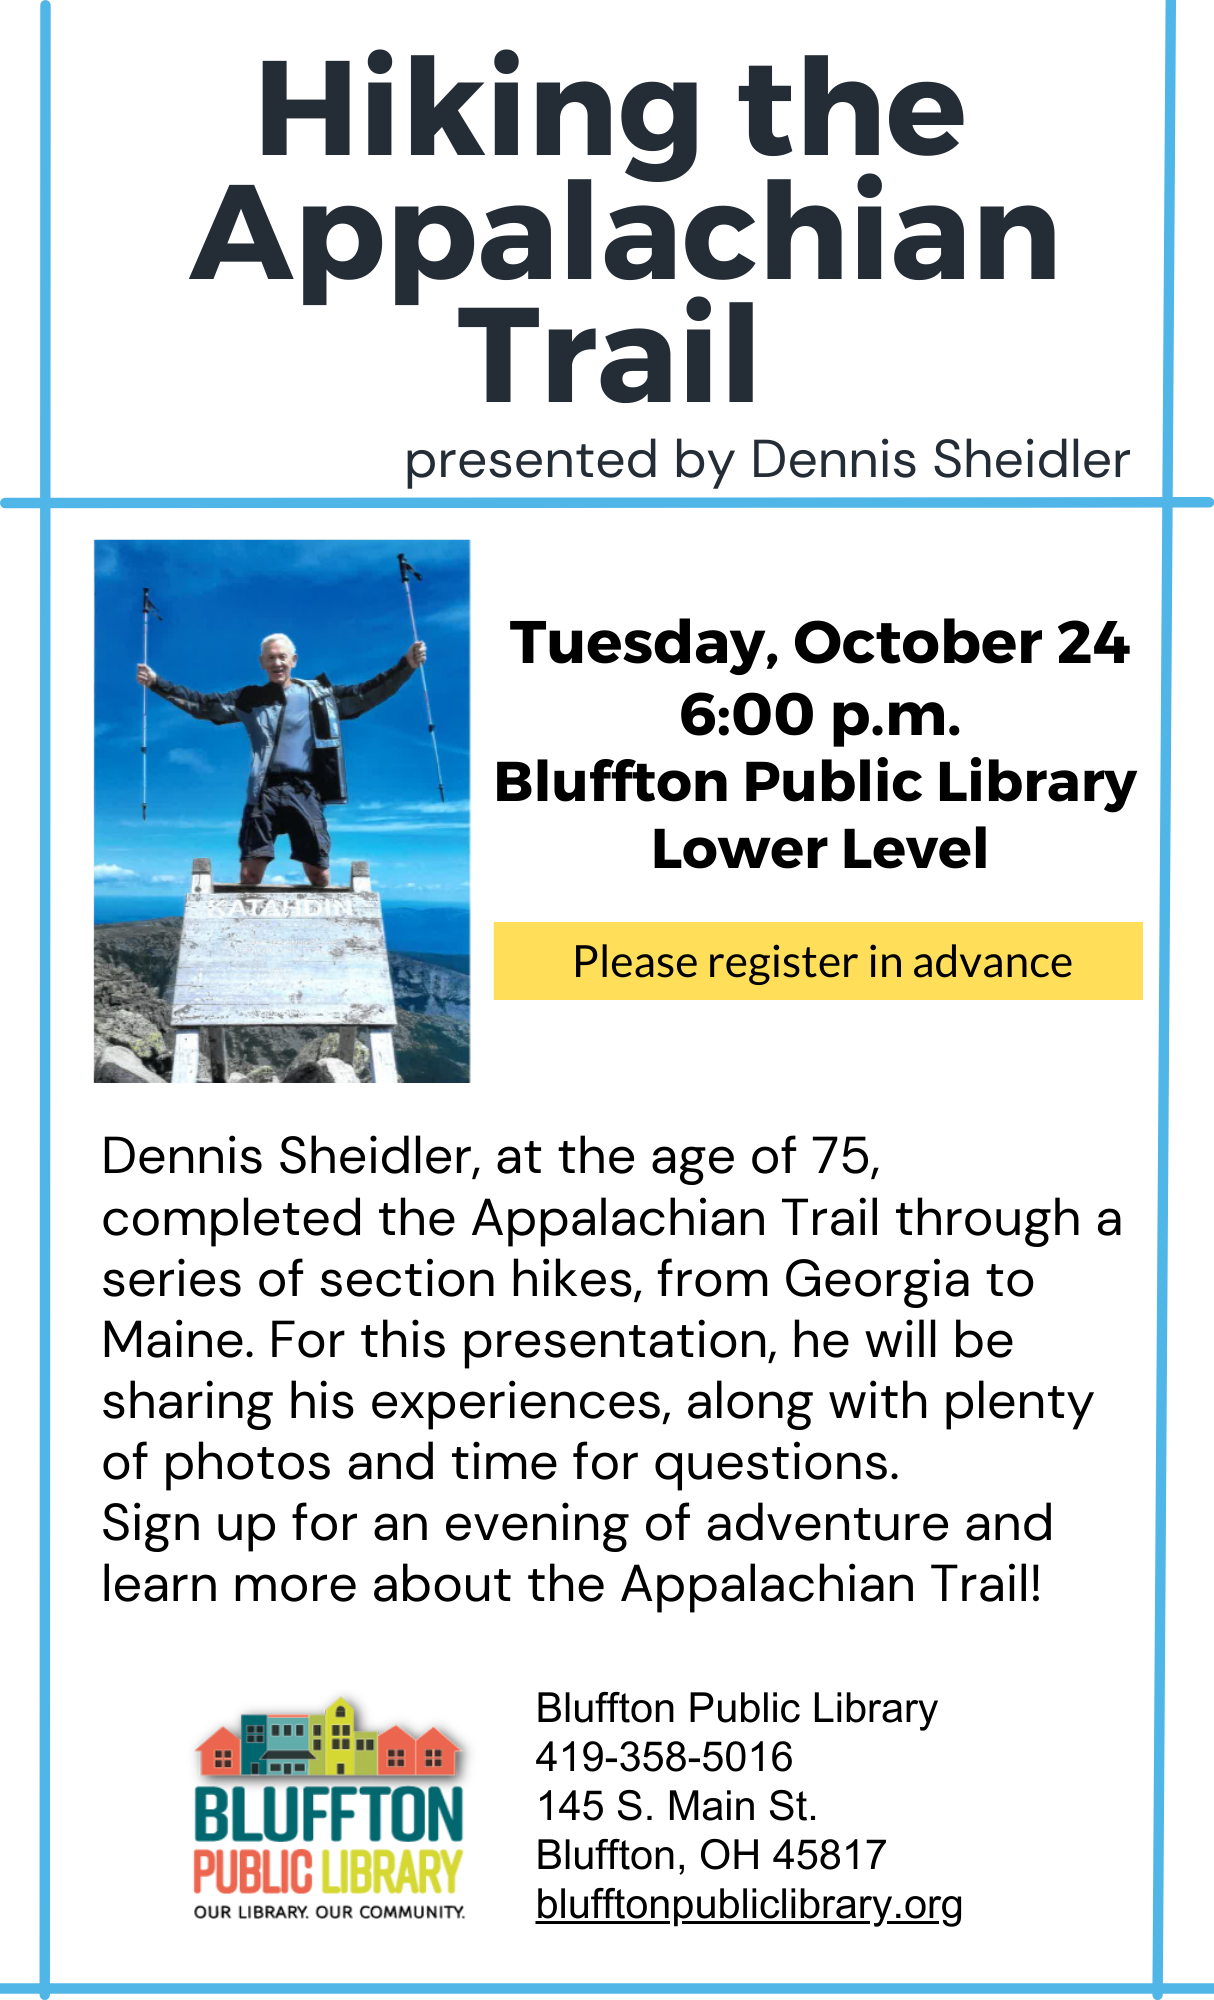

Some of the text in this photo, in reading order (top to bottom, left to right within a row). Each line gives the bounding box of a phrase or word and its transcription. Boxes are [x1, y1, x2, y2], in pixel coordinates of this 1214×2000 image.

[262, 49, 965, 181] Hiking the
[189, 174, 1056, 305] Appalachian
[458, 296, 753, 403] Trail
[408, 439, 1130, 489] presented by Dennis Sheidler
[510, 618, 1130, 675] Tuesday, October 24
[681, 692, 959, 747] 6:00 p.m.
[497, 757, 1138, 813] Bluffton Public Library
[655, 826, 986, 868] Lower Level
[207, 898, 353, 918] KATAHDIN
[576, 944, 1072, 985] Please register in advance
[105, 1136, 878, 1185] Dennis Sheidler, at the age of 75,
[103, 1198, 1121, 1247] completed the Appalachian Trail through a
[103, 1259, 1033, 1308] series of section hikes, from Georgia to
[105, 1320, 1012, 1367] Maine. For this presentation, he will be
[103, 1381, 1094, 1430] sharing his experiences, along with plenty
[103, 1442, 898, 1491] of photos and time for questions.
[103, 1503, 1051, 1552] Sign up for an evening of adventure and
[104, 1564, 1039, 1613] learn more about the Appalachian Trail!
[538, 1692, 938, 1731] Bluffton Public Library
[536, 1741, 792, 1772] 419-358-5016
[195, 1786, 463, 1842] BLUFFTON
[540, 1790, 815, 1821] 145 S. Main St.
[194, 1849, 462, 1893] PUBLIC LIBRARY
[538, 1839, 886, 1875] Bluffton, OH 45817
[194, 1906, 464, 1919] OUR LIBRARY. OUR COMMUNITY.
[535, 1888, 961, 1927] blufftonpubliclibrary.org
